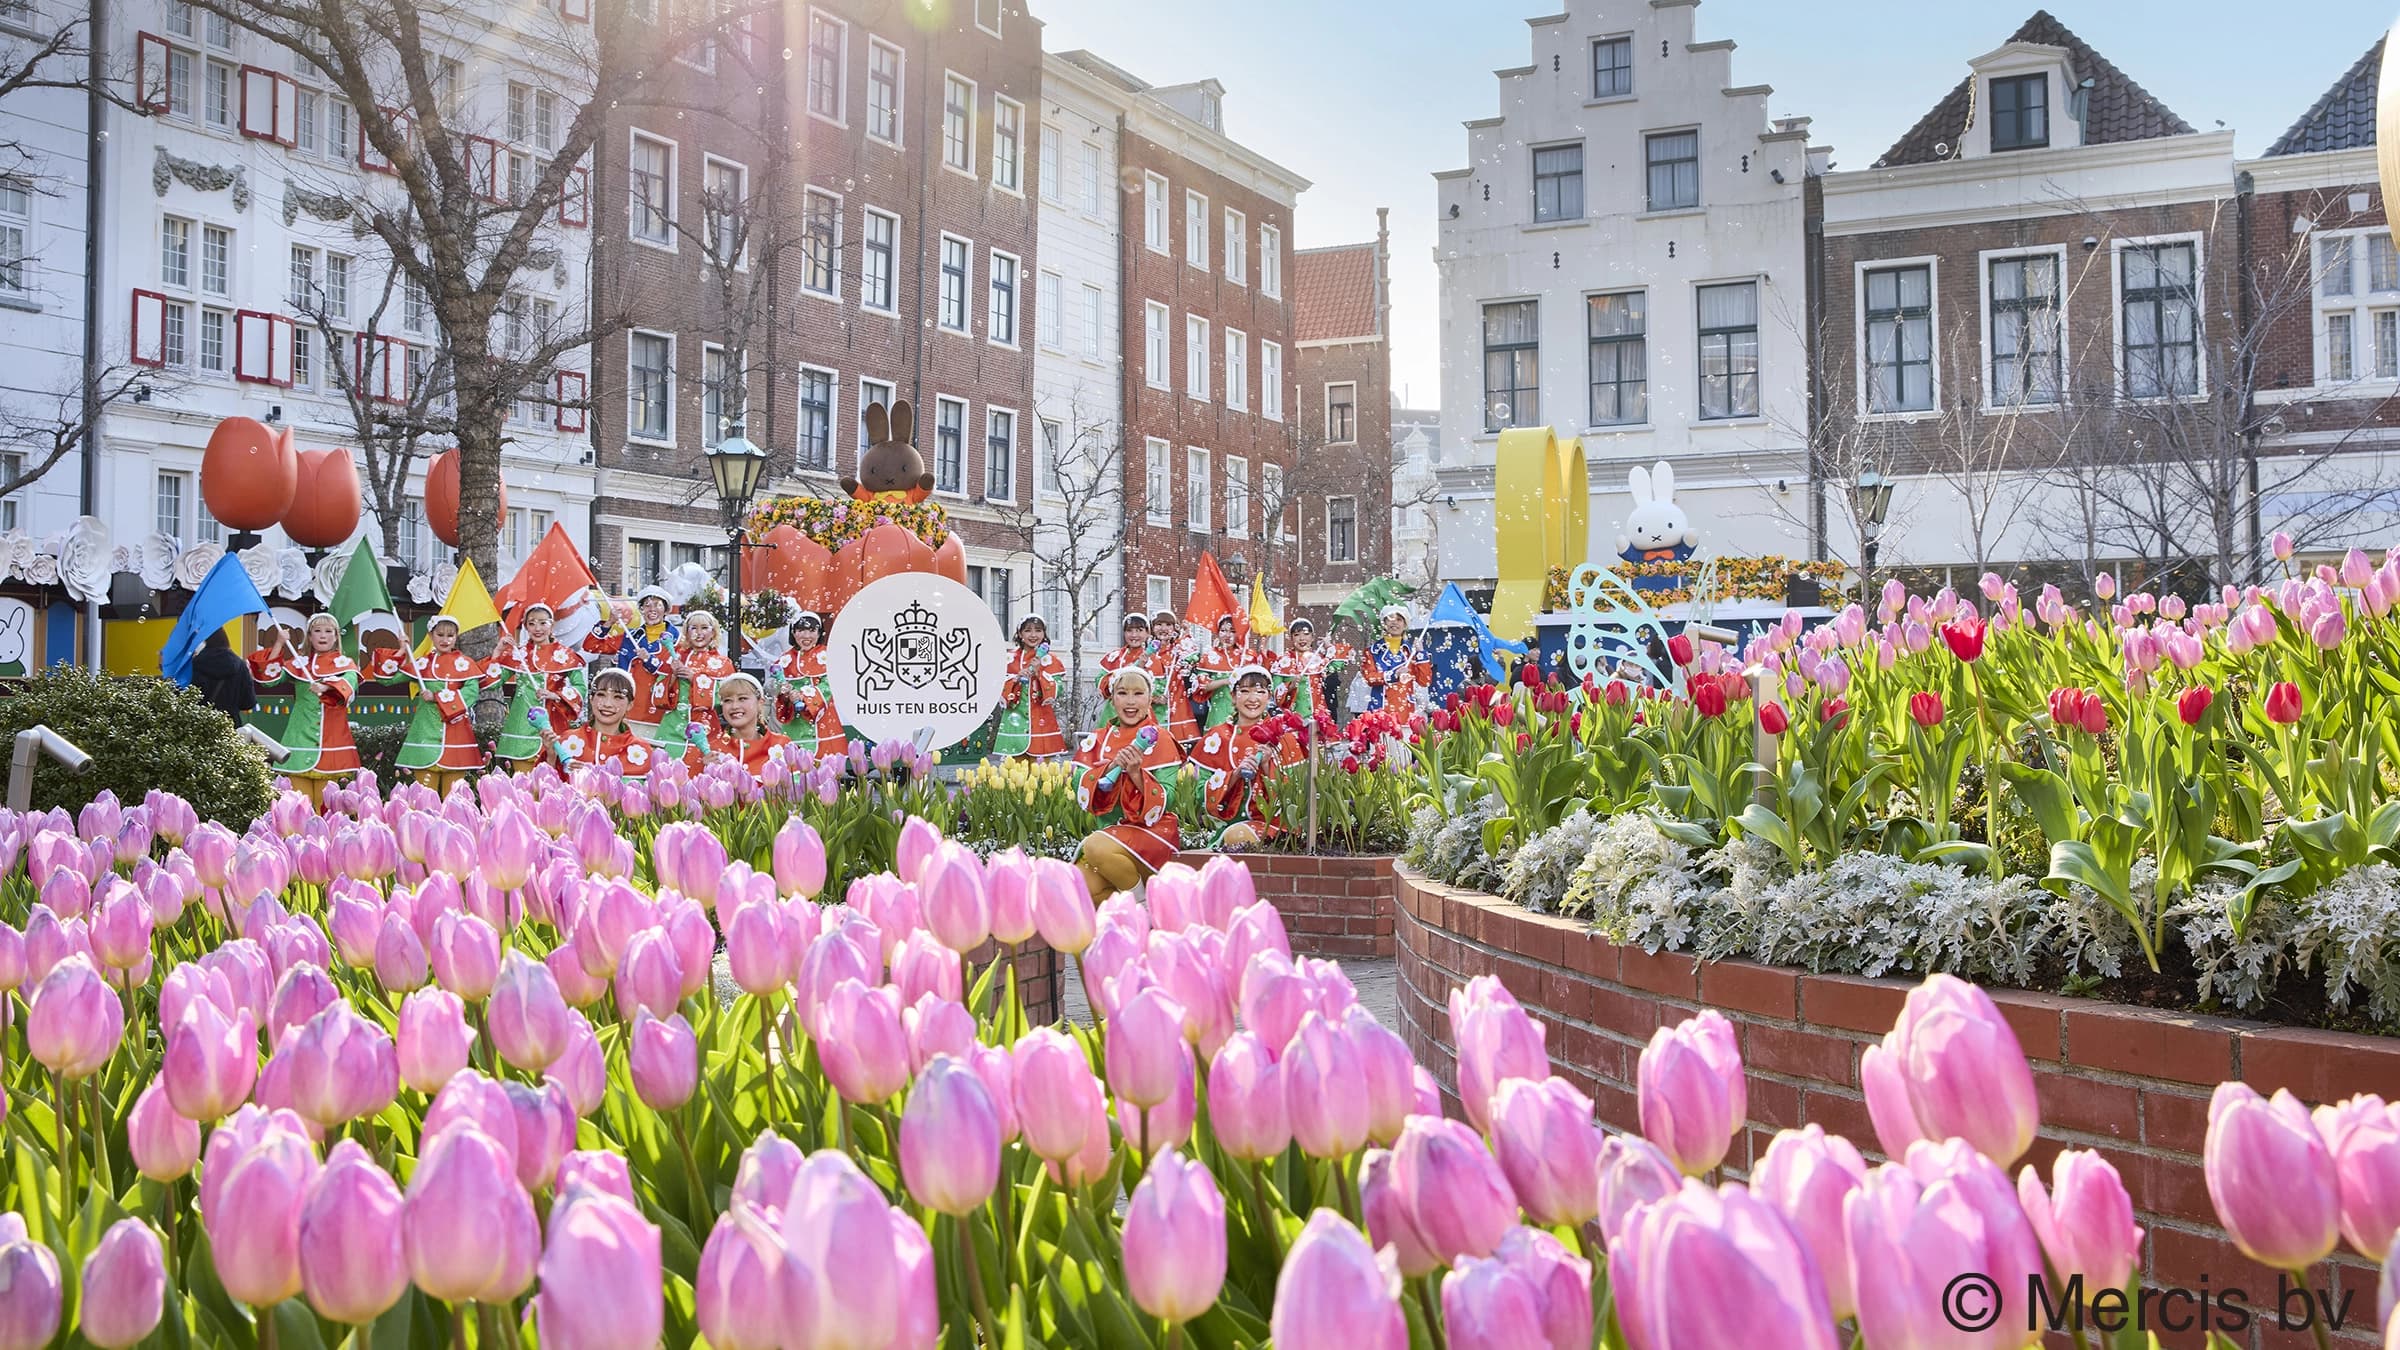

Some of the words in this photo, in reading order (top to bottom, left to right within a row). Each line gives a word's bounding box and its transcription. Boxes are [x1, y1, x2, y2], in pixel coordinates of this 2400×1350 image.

[857, 703, 891, 714] HUIS
[896, 703, 924, 714] TEN
[929, 702, 978, 714] BOSCH
